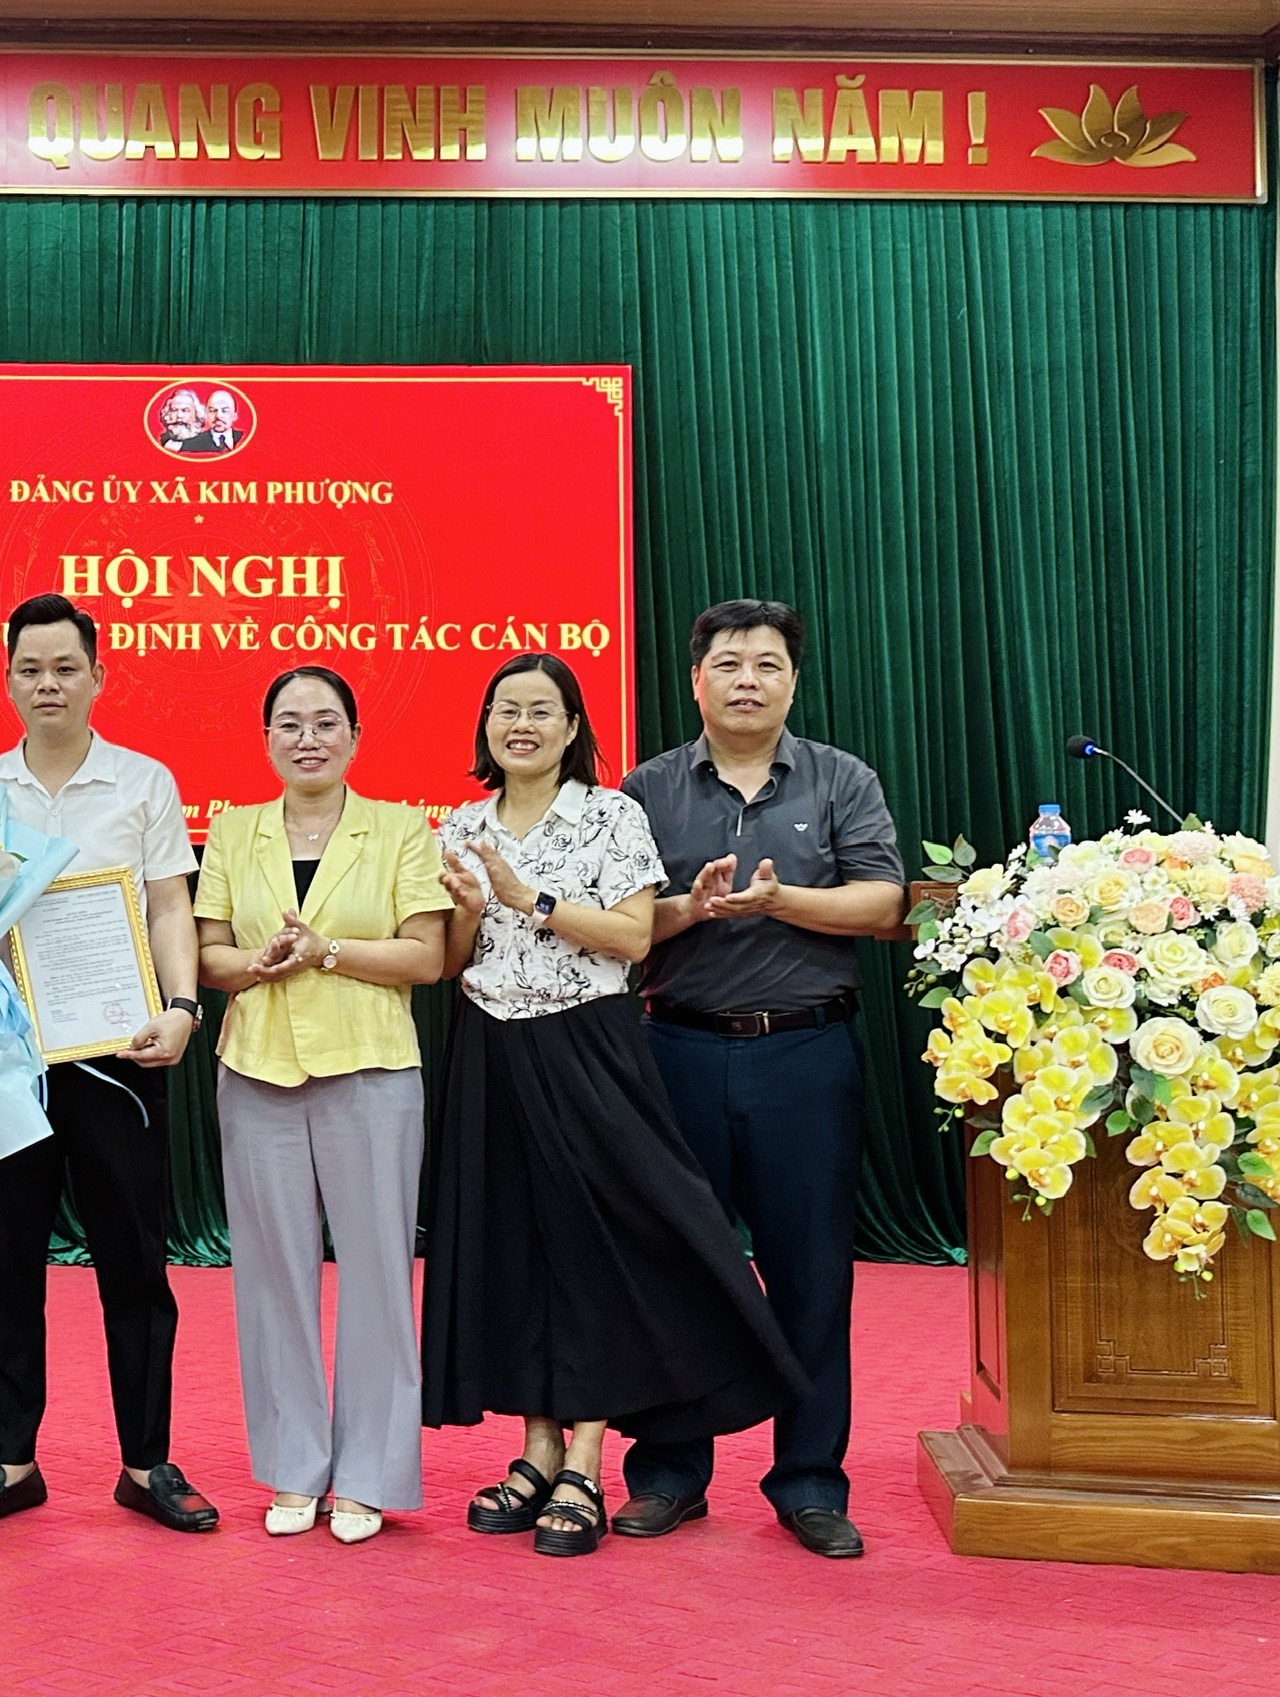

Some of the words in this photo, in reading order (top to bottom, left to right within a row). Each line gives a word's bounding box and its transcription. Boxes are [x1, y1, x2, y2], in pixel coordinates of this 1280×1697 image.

[27, 81, 283, 169] QUANG
[310, 83, 487, 162] VINH
[515, 70, 744, 164] MUÔN
[772, 74, 945, 165] NĂM
[9, 474, 95, 503] ĐẢNG
[103, 474, 143, 504] ỦY
[149, 476, 191, 504] XÃ
[198, 480, 258, 504] KIM
[266, 477, 394, 510] PHƯỢNG
[58, 548, 173, 609] HỘI
[188, 555, 345, 609] NGHỊ
[108, 622, 202, 657] ĐỊNH
[211, 615, 260, 650] VỀ
[269, 615, 377, 651] CÔNG
[385, 615, 461, 651] TÁC
[470, 615, 548, 651] CÁN
[559, 618, 610, 658] BỘ
